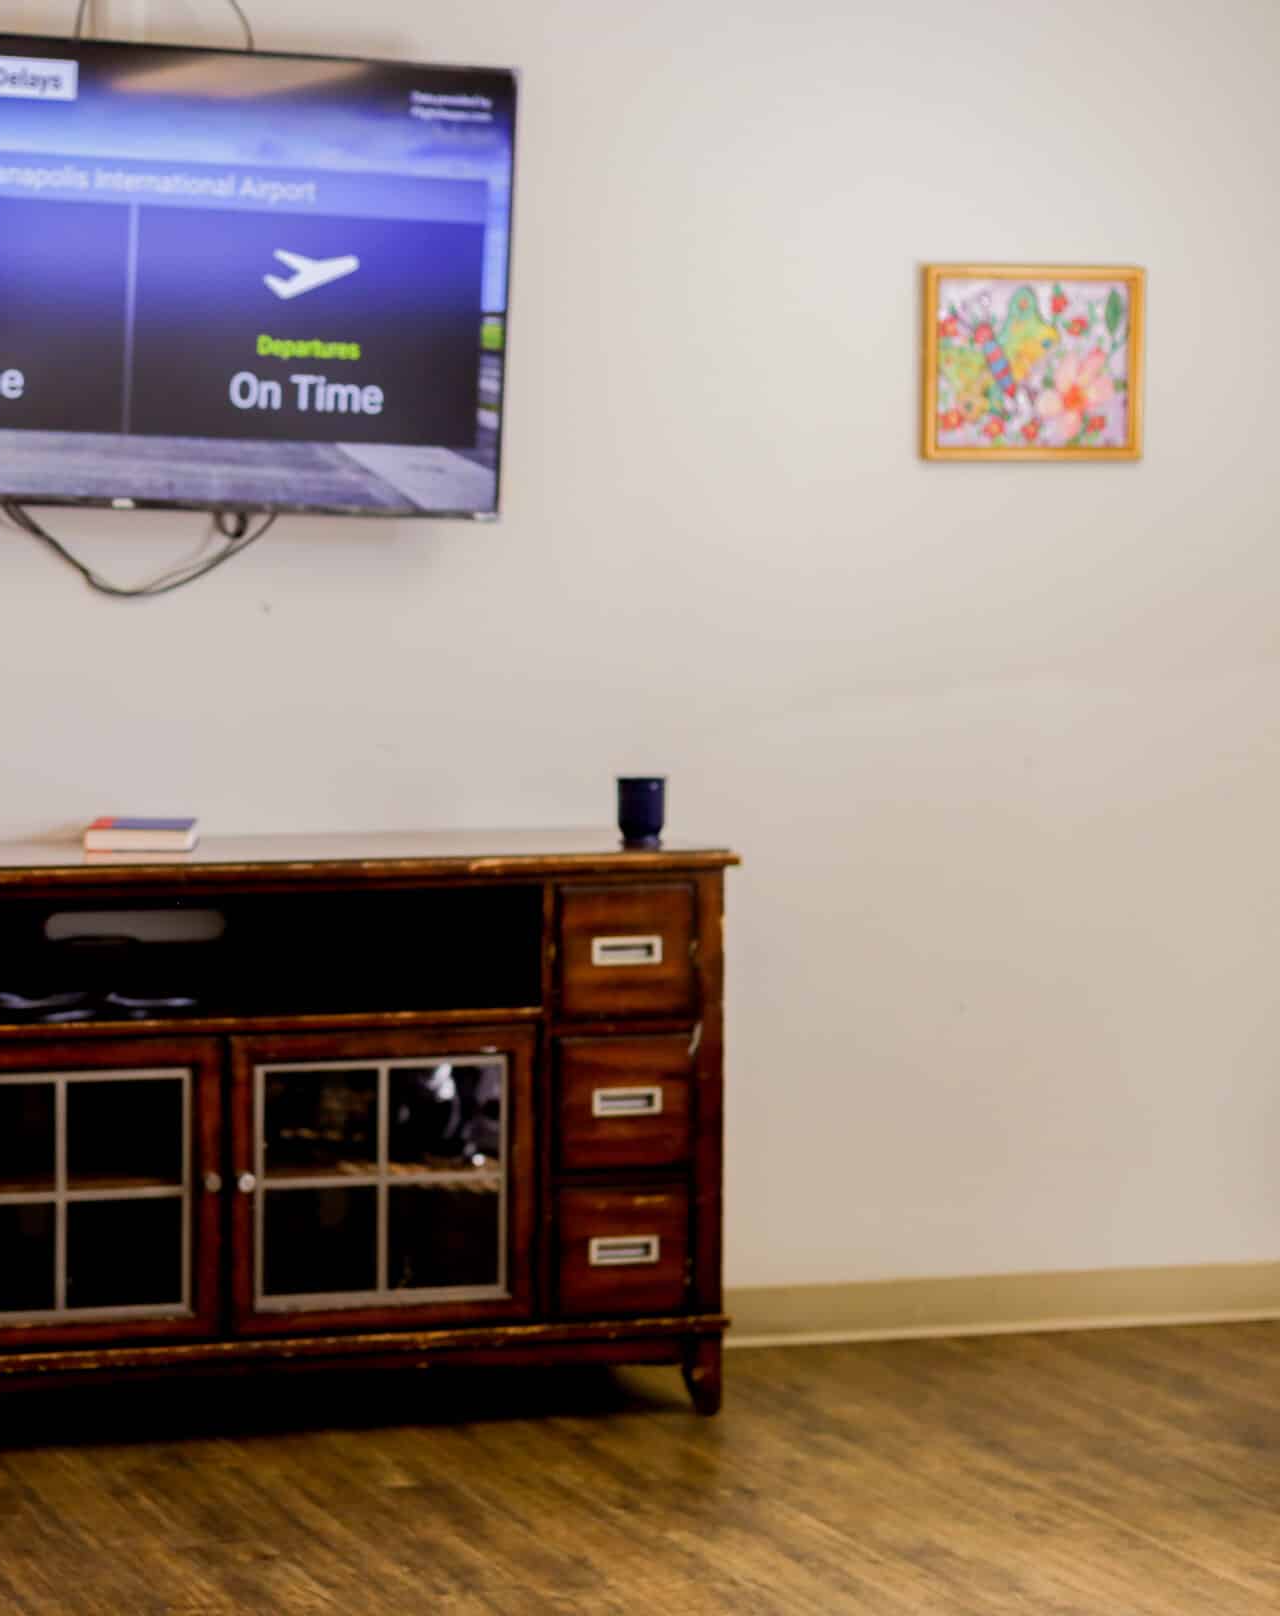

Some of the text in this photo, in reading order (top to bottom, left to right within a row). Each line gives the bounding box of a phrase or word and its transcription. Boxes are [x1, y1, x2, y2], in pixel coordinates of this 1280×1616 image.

[94, 167, 236, 196] International
[238, 175, 316, 205] Airport
[256, 333, 361, 361] Departures
[229, 370, 385, 415] On Time
